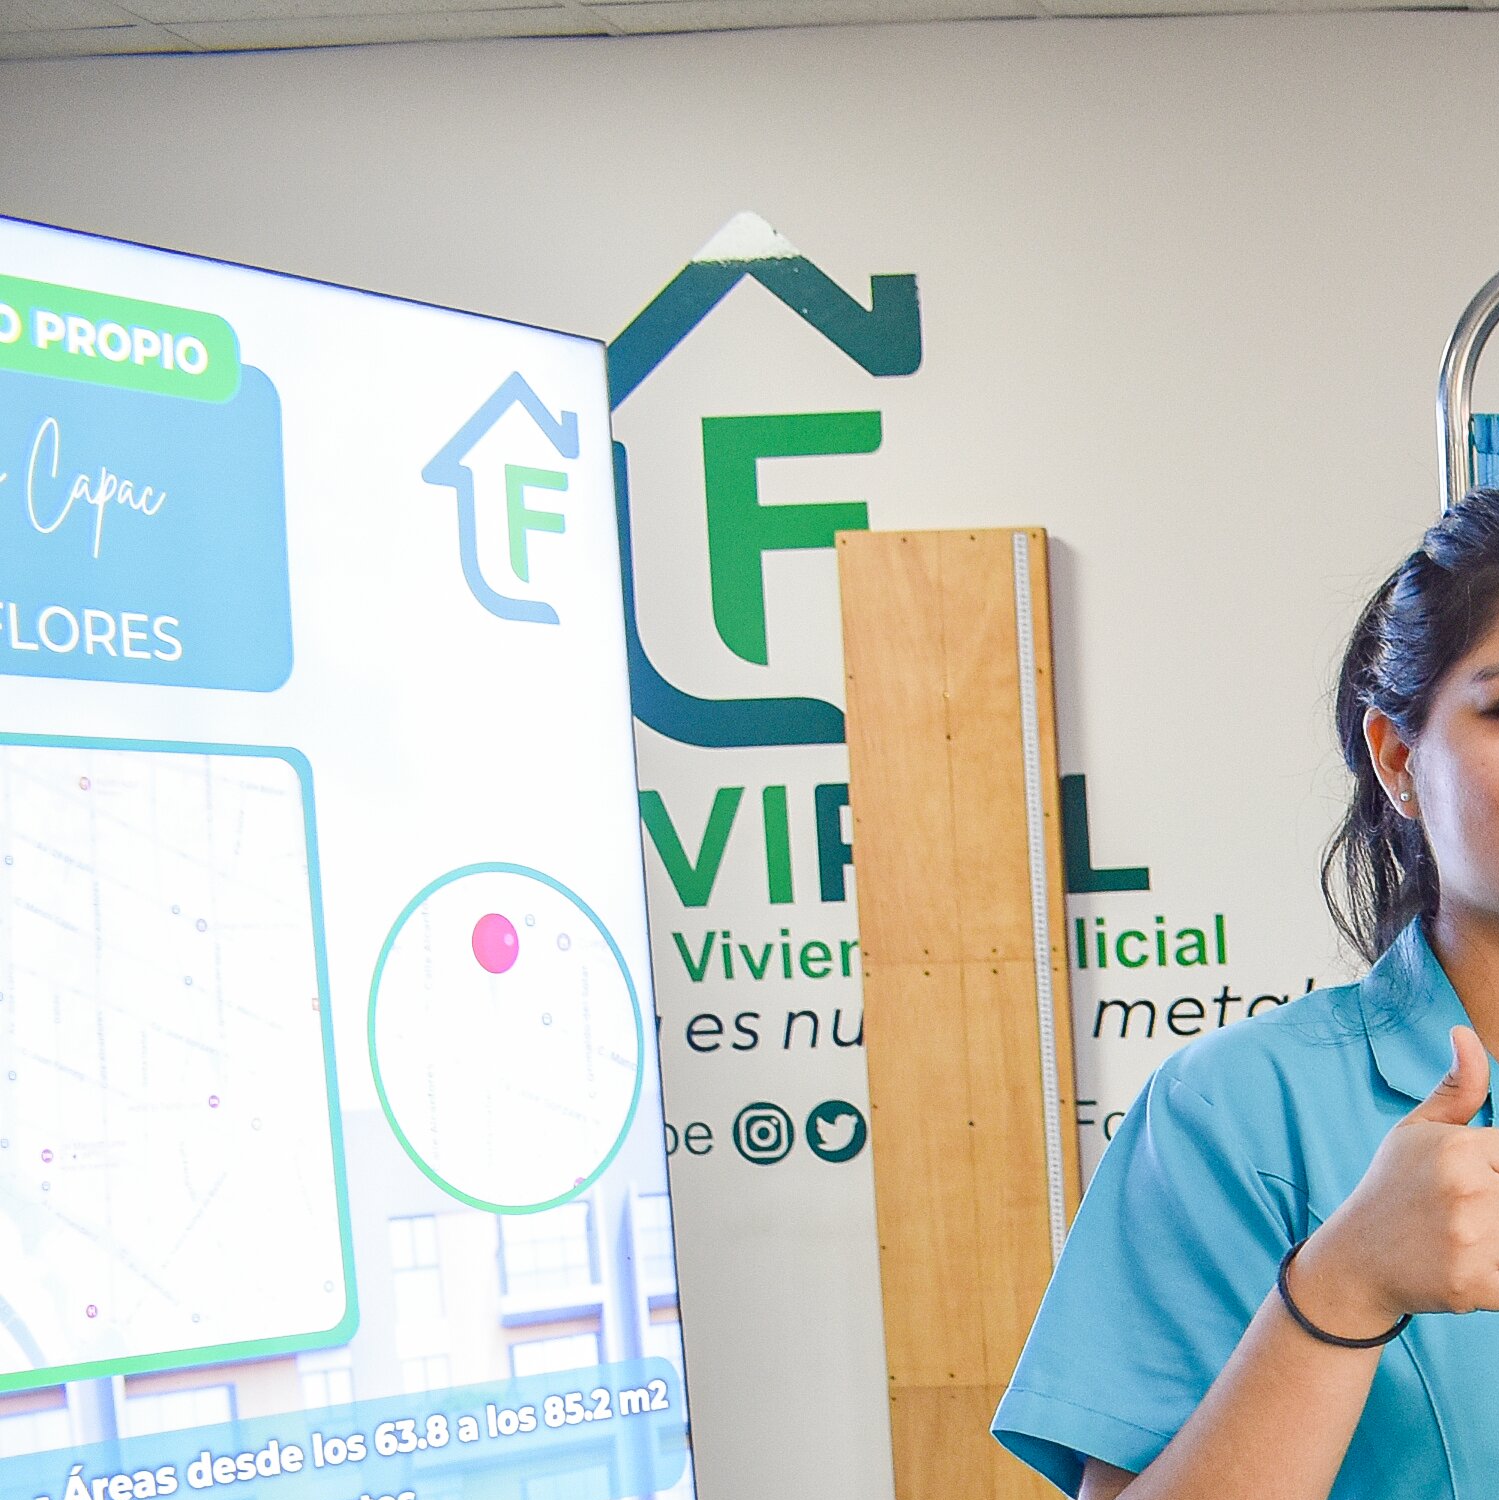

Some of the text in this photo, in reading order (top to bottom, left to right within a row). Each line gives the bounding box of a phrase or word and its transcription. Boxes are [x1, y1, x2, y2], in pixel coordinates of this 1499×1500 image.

[34, 309, 208, 375] PROPIO
[27, 416, 166, 559] Capac
[0, 601, 183, 662] LORES
[686, 1008, 760, 1053] es
[187, 1439, 304, 1490] desde
[312, 1432, 367, 1468] los
[374, 1413, 450, 1457] 63.8
[457, 1415, 480, 1444] a
[486, 1403, 538, 1439] los
[543, 1387, 613, 1428] 85.2
[619, 1378, 670, 1416] m2
